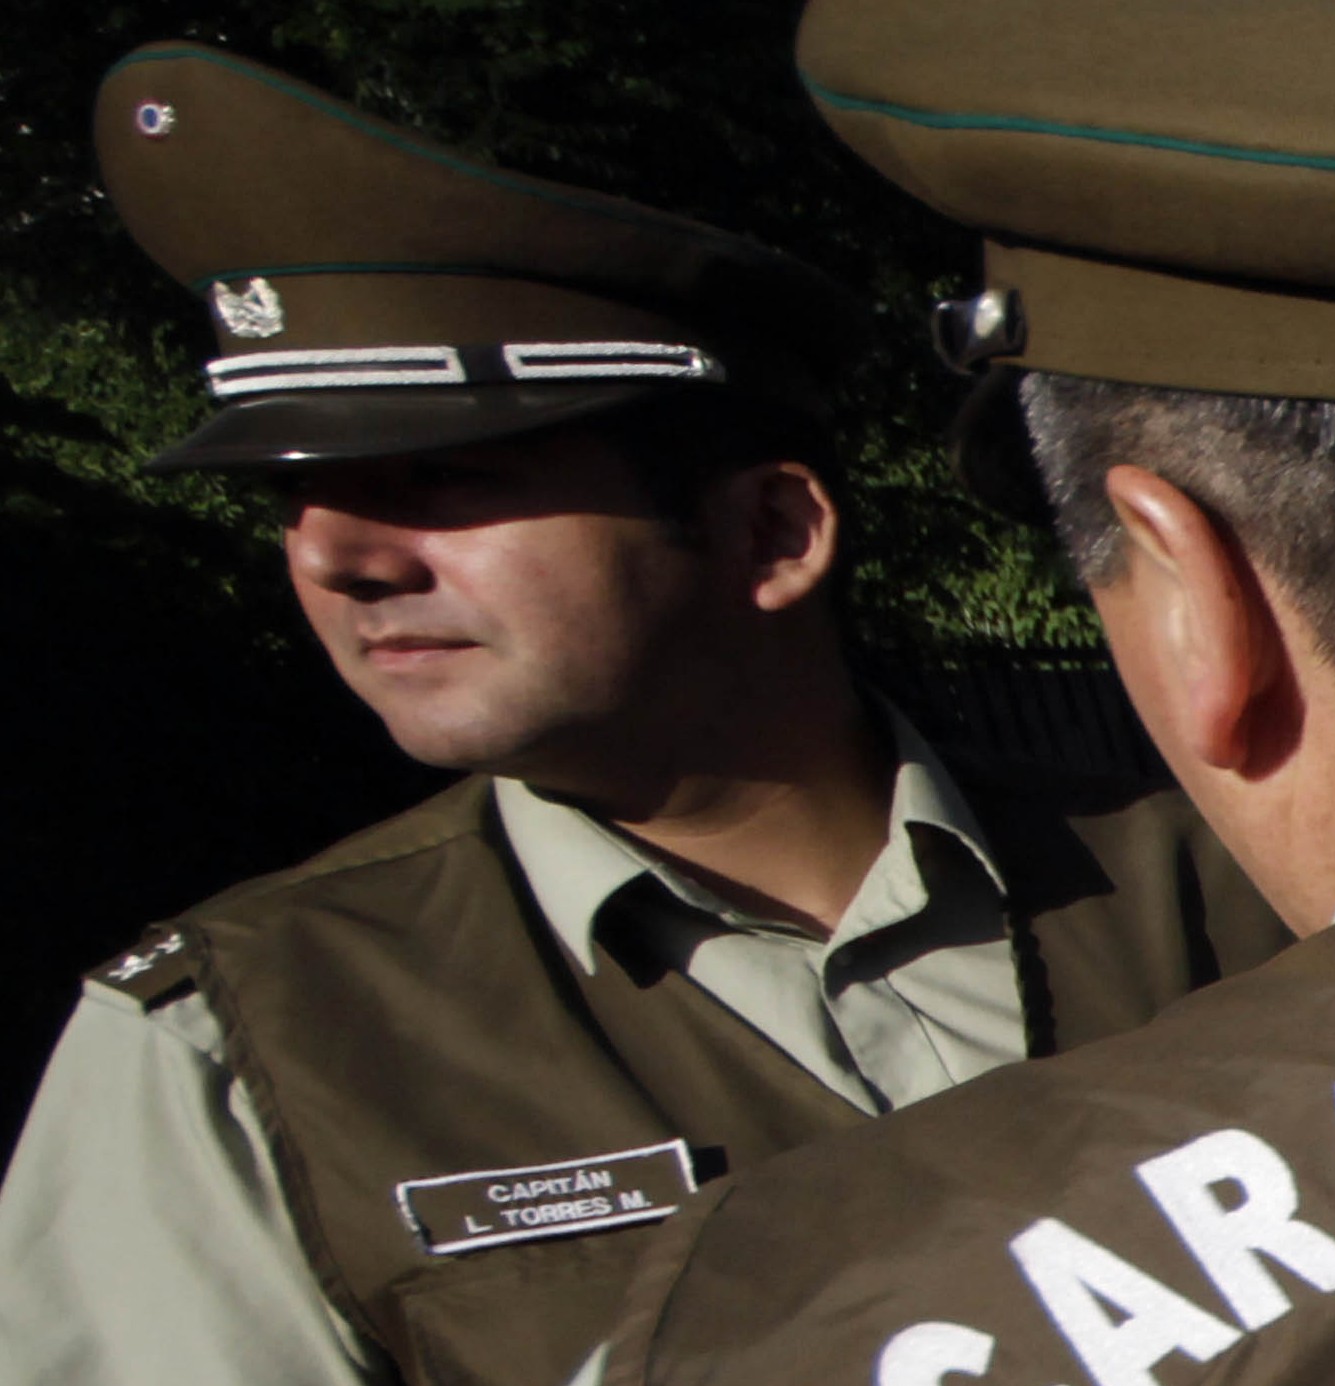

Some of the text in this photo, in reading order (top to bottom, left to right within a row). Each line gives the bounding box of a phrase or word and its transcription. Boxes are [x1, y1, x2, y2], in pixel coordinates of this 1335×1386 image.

[487, 1169, 612, 1203] CAPITÁN
[500, 1196, 613, 1226] TORRES
[618, 1189, 653, 1210] M.
